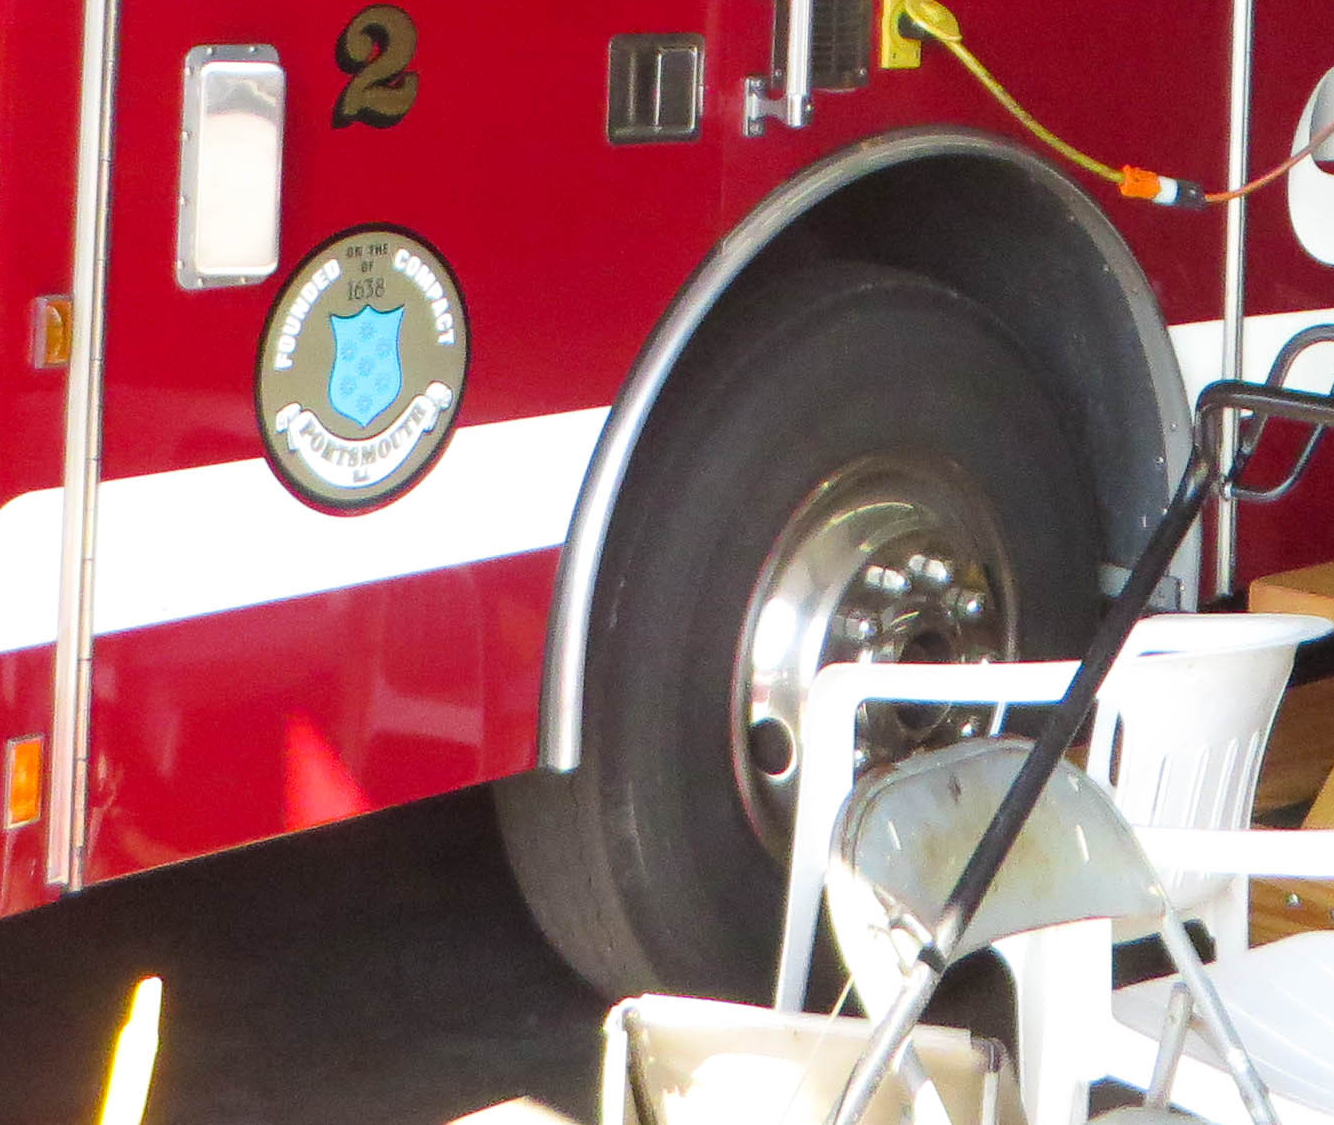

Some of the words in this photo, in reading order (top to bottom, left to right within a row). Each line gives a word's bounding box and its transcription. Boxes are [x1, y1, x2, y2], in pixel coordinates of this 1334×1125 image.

[331, 3, 420, 130] 2
[346, 275, 386, 301] 1638
[369, 242, 389, 256] THE
[273, 258, 342, 371] FOUNDED
[394, 248, 456, 346] COMPACT
[298, 401, 427, 469] PORTSMOUTH
